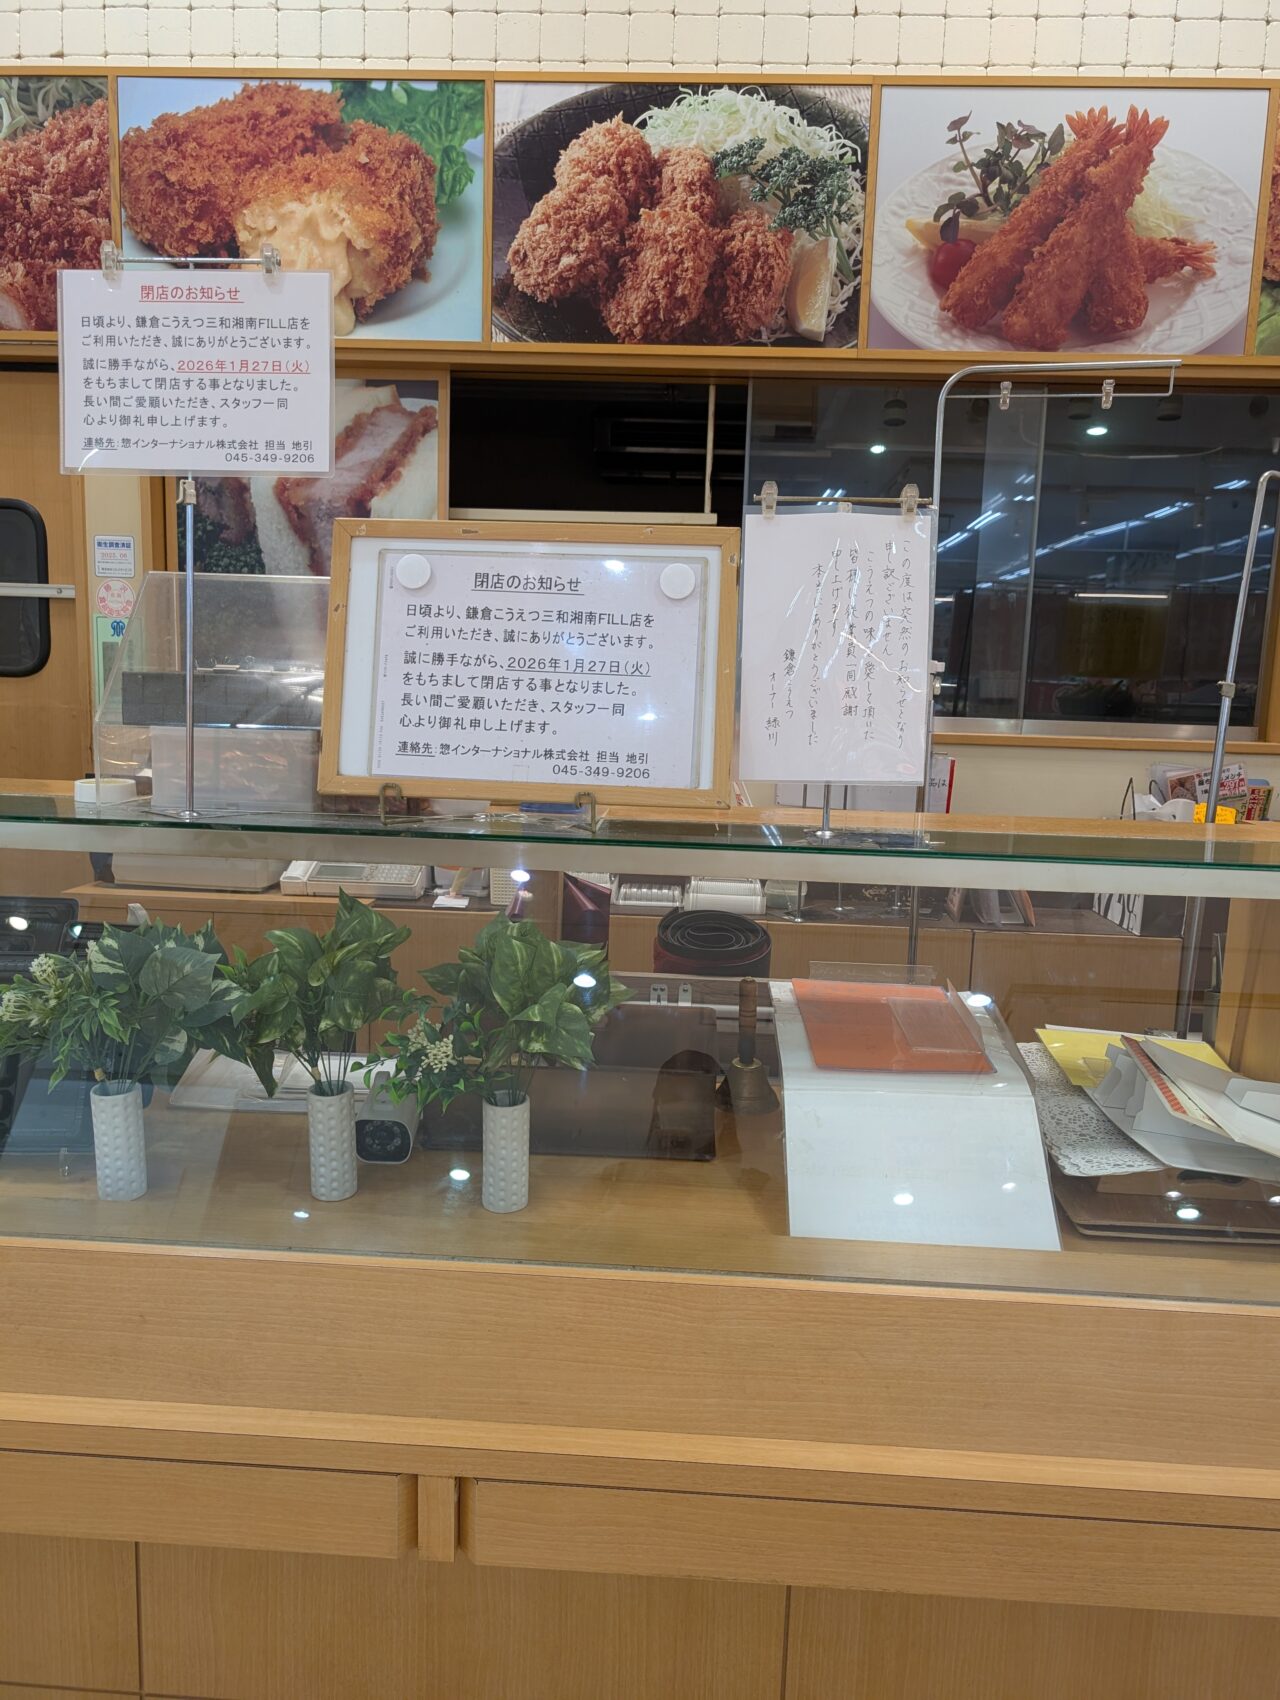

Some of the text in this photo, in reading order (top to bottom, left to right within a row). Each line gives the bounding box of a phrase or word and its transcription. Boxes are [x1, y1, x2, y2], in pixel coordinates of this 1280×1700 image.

[140, 285, 241, 301] 閉店のお知らせ
[81, 315, 310, 330] 日頃より、鎌倉こうえつ三和湘南FILL店を
[81, 334, 311, 349] ご利用いただき、誠にありがとうございます。
[82, 358, 310, 372] 誠に勝手ながら、2026年1月27日（火）
[82, 377, 299, 391] をもちまして閉店する事となりました。
[82, 396, 288, 410] 長い間ご愛顧いただき、スタッフ一同
[83, 415, 228, 428] 心より御礼申し上げます。
[264, 440, 286, 451] 担当
[292, 440, 313, 451] 地引
[225, 453, 315, 463] 045-349-9206
[473, 572, 583, 593] 閉店のお知らせ
[406, 604, 655, 628] 日頃より、鎌倉こうえつ三和湘南FILL店を
[405, 626, 654, 650] ご利用いただき、誠にありがとうございます。
[403, 651, 650, 675] 誠に勝手ながら、2026年1月27日（火）
[402, 671, 638, 696] をもちまして閉店する事となりました。
[401, 693, 625, 717] 長い間ご愛顧いただき、スタッフ一同
[400, 715, 558, 736] 心より御礼申し上げます。
[596, 752, 620, 764] 担当
[626, 752, 650, 765] 地引
[552, 764, 651, 779] 045-349-9206
